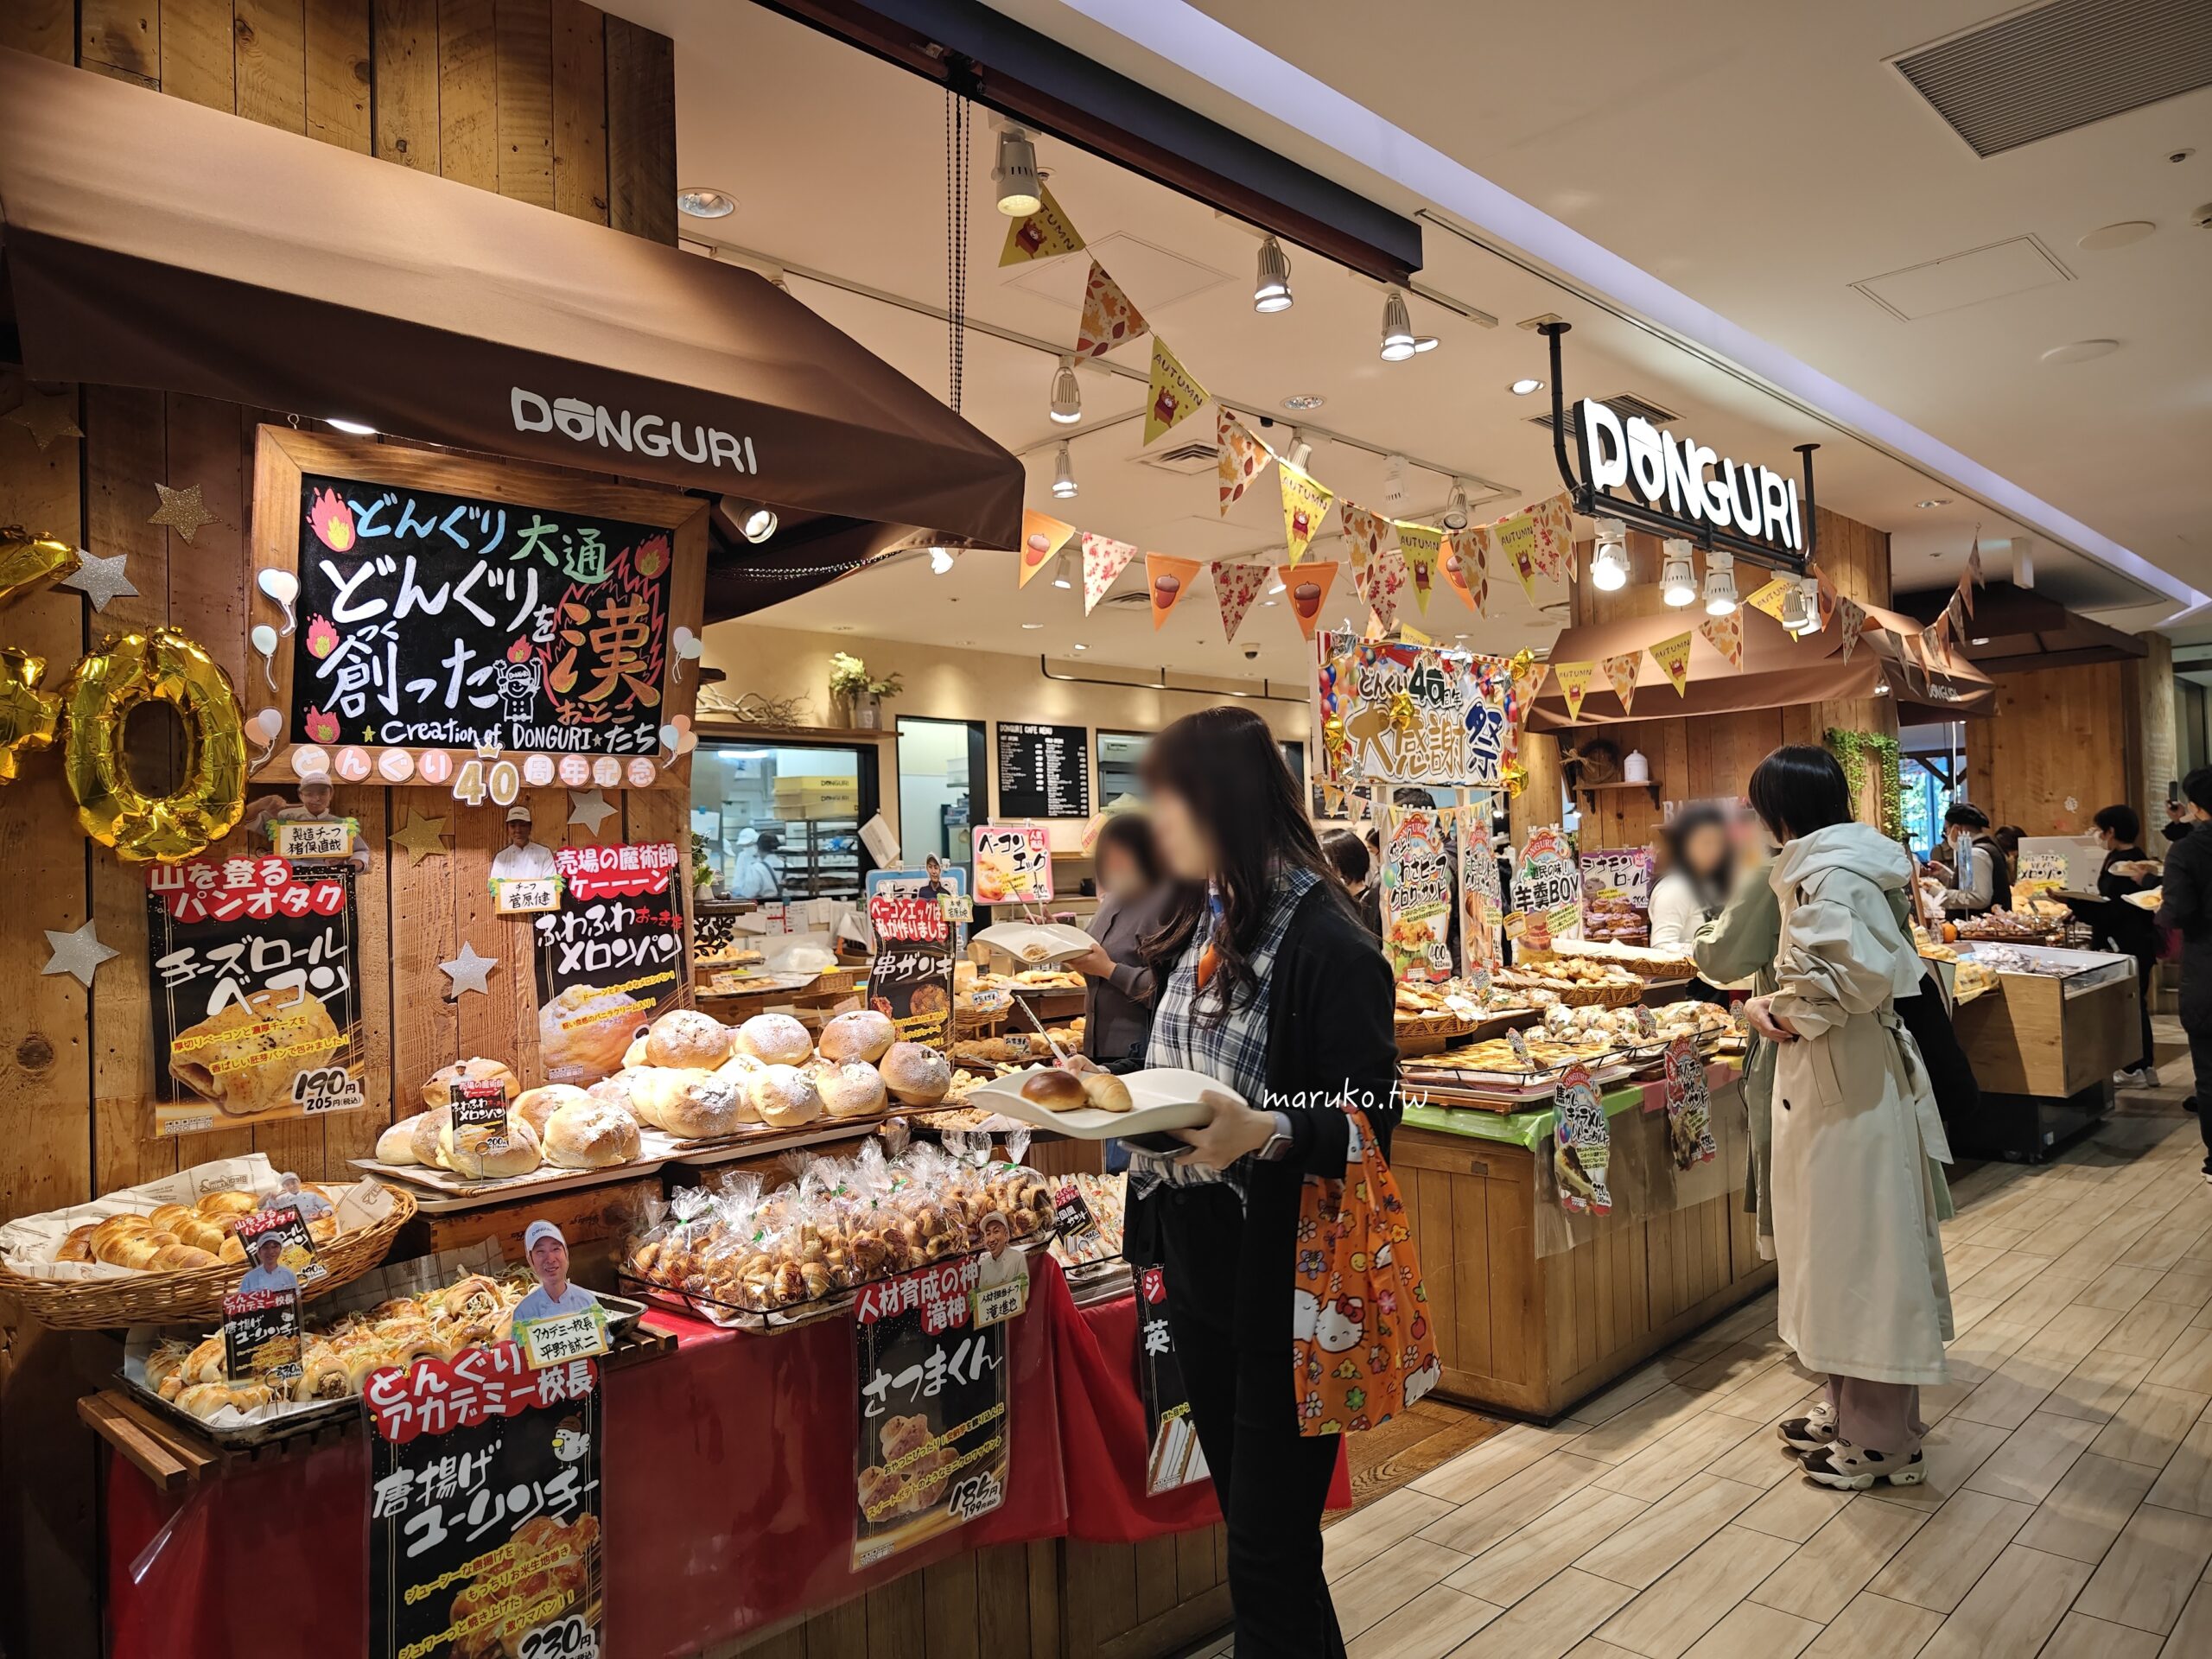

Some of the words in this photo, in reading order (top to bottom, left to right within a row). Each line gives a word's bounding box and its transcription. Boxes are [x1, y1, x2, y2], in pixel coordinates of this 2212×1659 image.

[1039, 204, 1074, 251] TUMN
[1153, 353, 1203, 407] AUTUMN
[511, 387, 757, 474] DONGURI
[1583, 397, 1804, 551] DONGURI
[1281, 476, 1328, 512] AUTUMN
[1401, 535, 1440, 551] AUTUMN
[1501, 526, 1534, 546] AUTUMN
[1758, 582, 1791, 607] AUTUM
[549, 594, 662, 708] 漢
[1655, 639, 1692, 659] AUTUMN
[1558, 667, 1593, 679] AUTUMN
[381, 720, 478, 744] Creation
[512, 723, 593, 753] DONGURI
[292, 826, 341, 842] 製造チーフ
[979, 834, 1025, 855] ベーコン
[150, 859, 288, 891] 山を登る
[556, 842, 679, 874] 売場の魔術師
[1582, 855, 1632, 874] シナモン
[1614, 869, 1649, 887] ロール
[175, 885, 343, 918] パンオタク
[871, 900, 942, 922] ベーコンエッグは
[535, 901, 635, 947] ふわふわ
[875, 918, 947, 939] 私が作りました
[156, 927, 348, 988] チーズロール
[557, 933, 683, 975] メロンパン
[874, 950, 955, 984] 串ザンギ
[207, 965, 351, 1017] ベーコン
[532, 1316, 595, 1343] アカデミー校長
[371, 1341, 521, 1405] どんぐり
[862, 1336, 1003, 1418] さつまくん
[382, 1361, 594, 1440] アカデミー校長
[373, 1440, 502, 1518] 唐揚げ
[404, 1466, 600, 1557] ユーリンチー
[405, 1544, 515, 1604] ジューシーな唐揚げを
[467, 1544, 570, 1602] もっちりお米生地巻き
